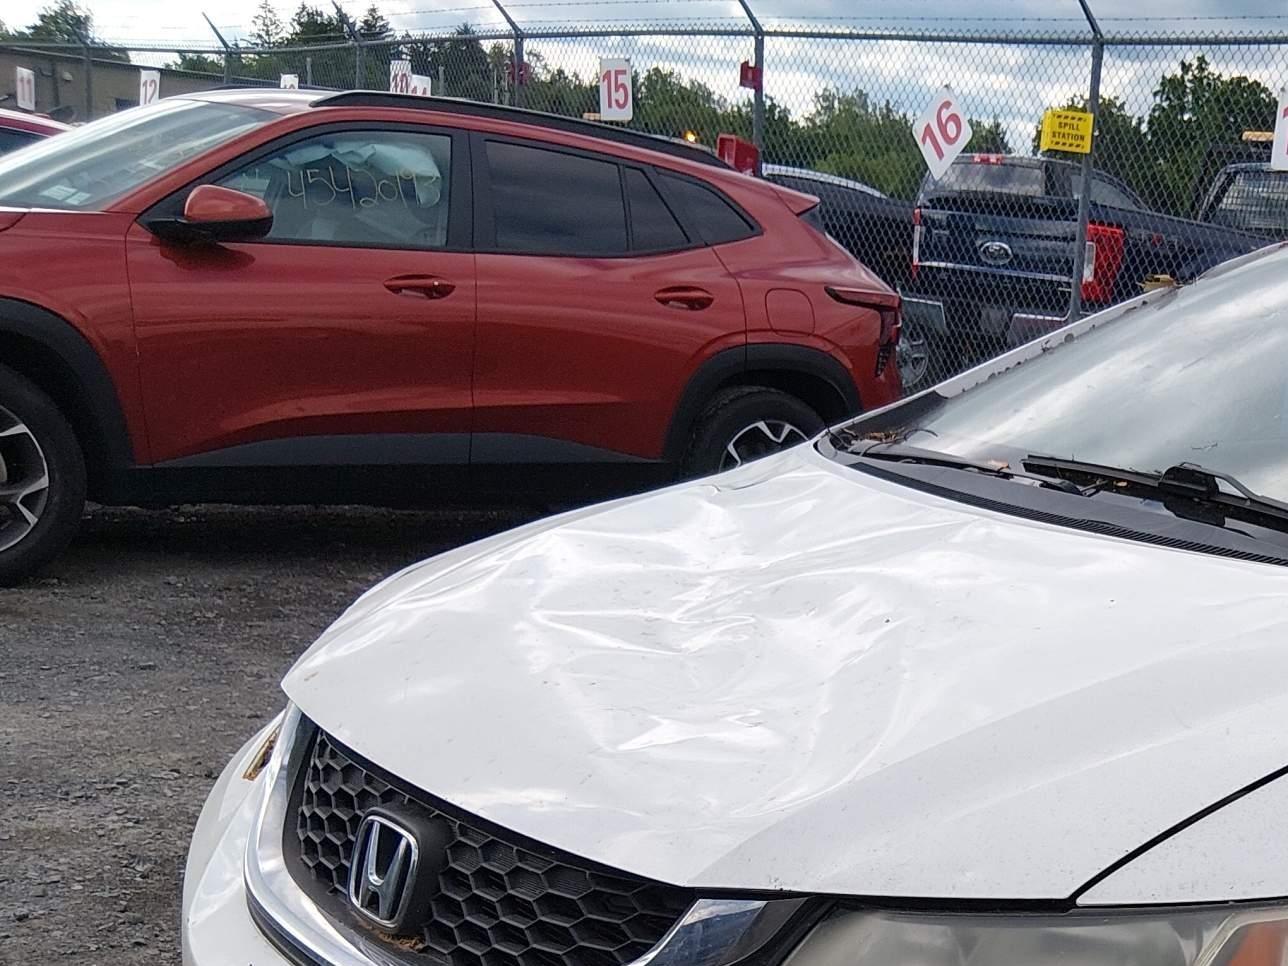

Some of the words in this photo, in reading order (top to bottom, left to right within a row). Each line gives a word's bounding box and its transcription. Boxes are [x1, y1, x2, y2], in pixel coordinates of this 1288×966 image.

[19, 76, 32, 104] 11
[142, 79, 157, 105] 12
[602, 69, 629, 109] 15
[920, 99, 962, 161] 16
[1051, 131, 1085, 142] STATION
[1058, 121, 1081, 132] SPILL
